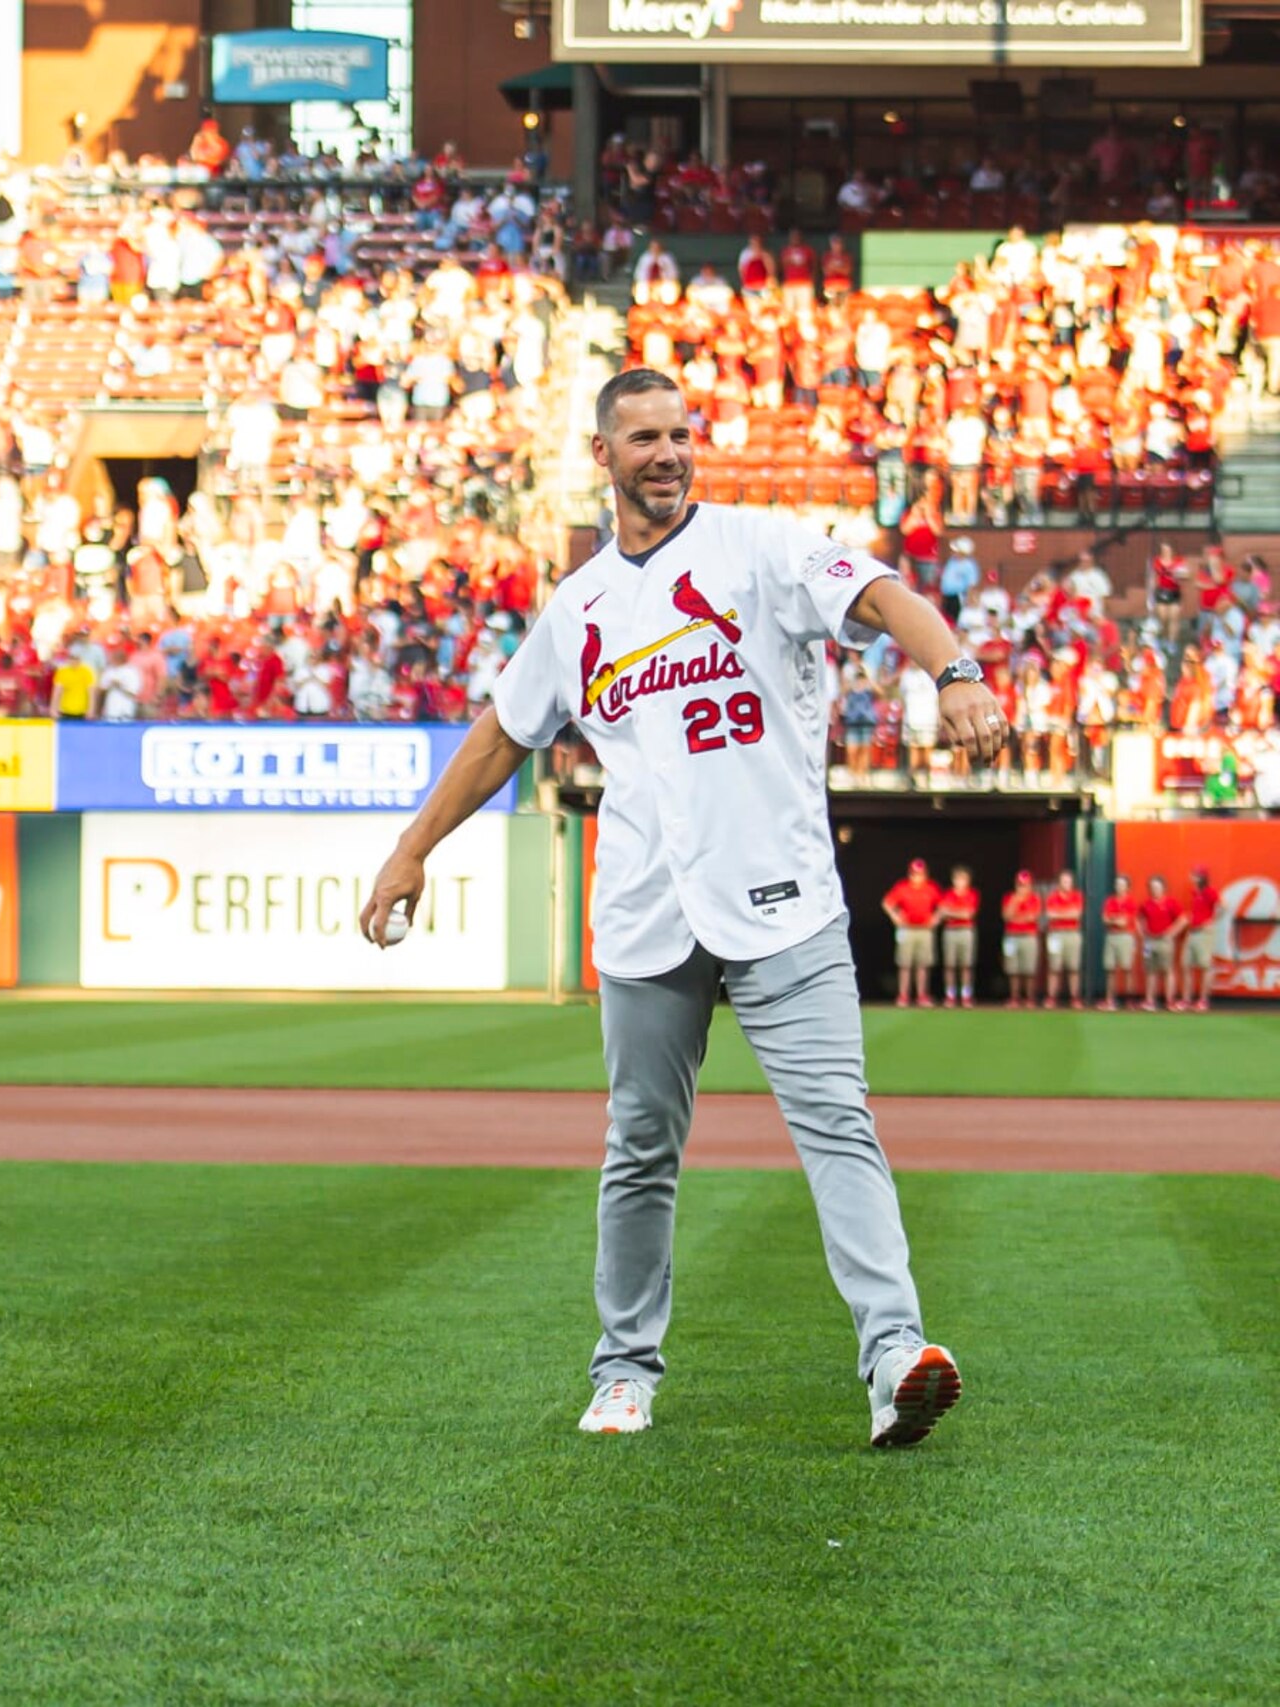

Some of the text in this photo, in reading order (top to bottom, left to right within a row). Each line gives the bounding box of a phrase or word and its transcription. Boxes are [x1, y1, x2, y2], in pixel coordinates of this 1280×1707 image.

[608, 0, 711, 39] Mercy
[760, 0, 839, 23] Medical
[841, 0, 922, 24] Provider
[923, 0, 945, 25] of
[946, 1, 978, 25] the
[1056, 1, 1146, 26] Cardinals
[596, 641, 745, 723] Cardinals
[681, 690, 765, 755] 29
[153, 741, 417, 778] ROTTLER
[154, 787, 416, 806] PEST SOLUTIONS
